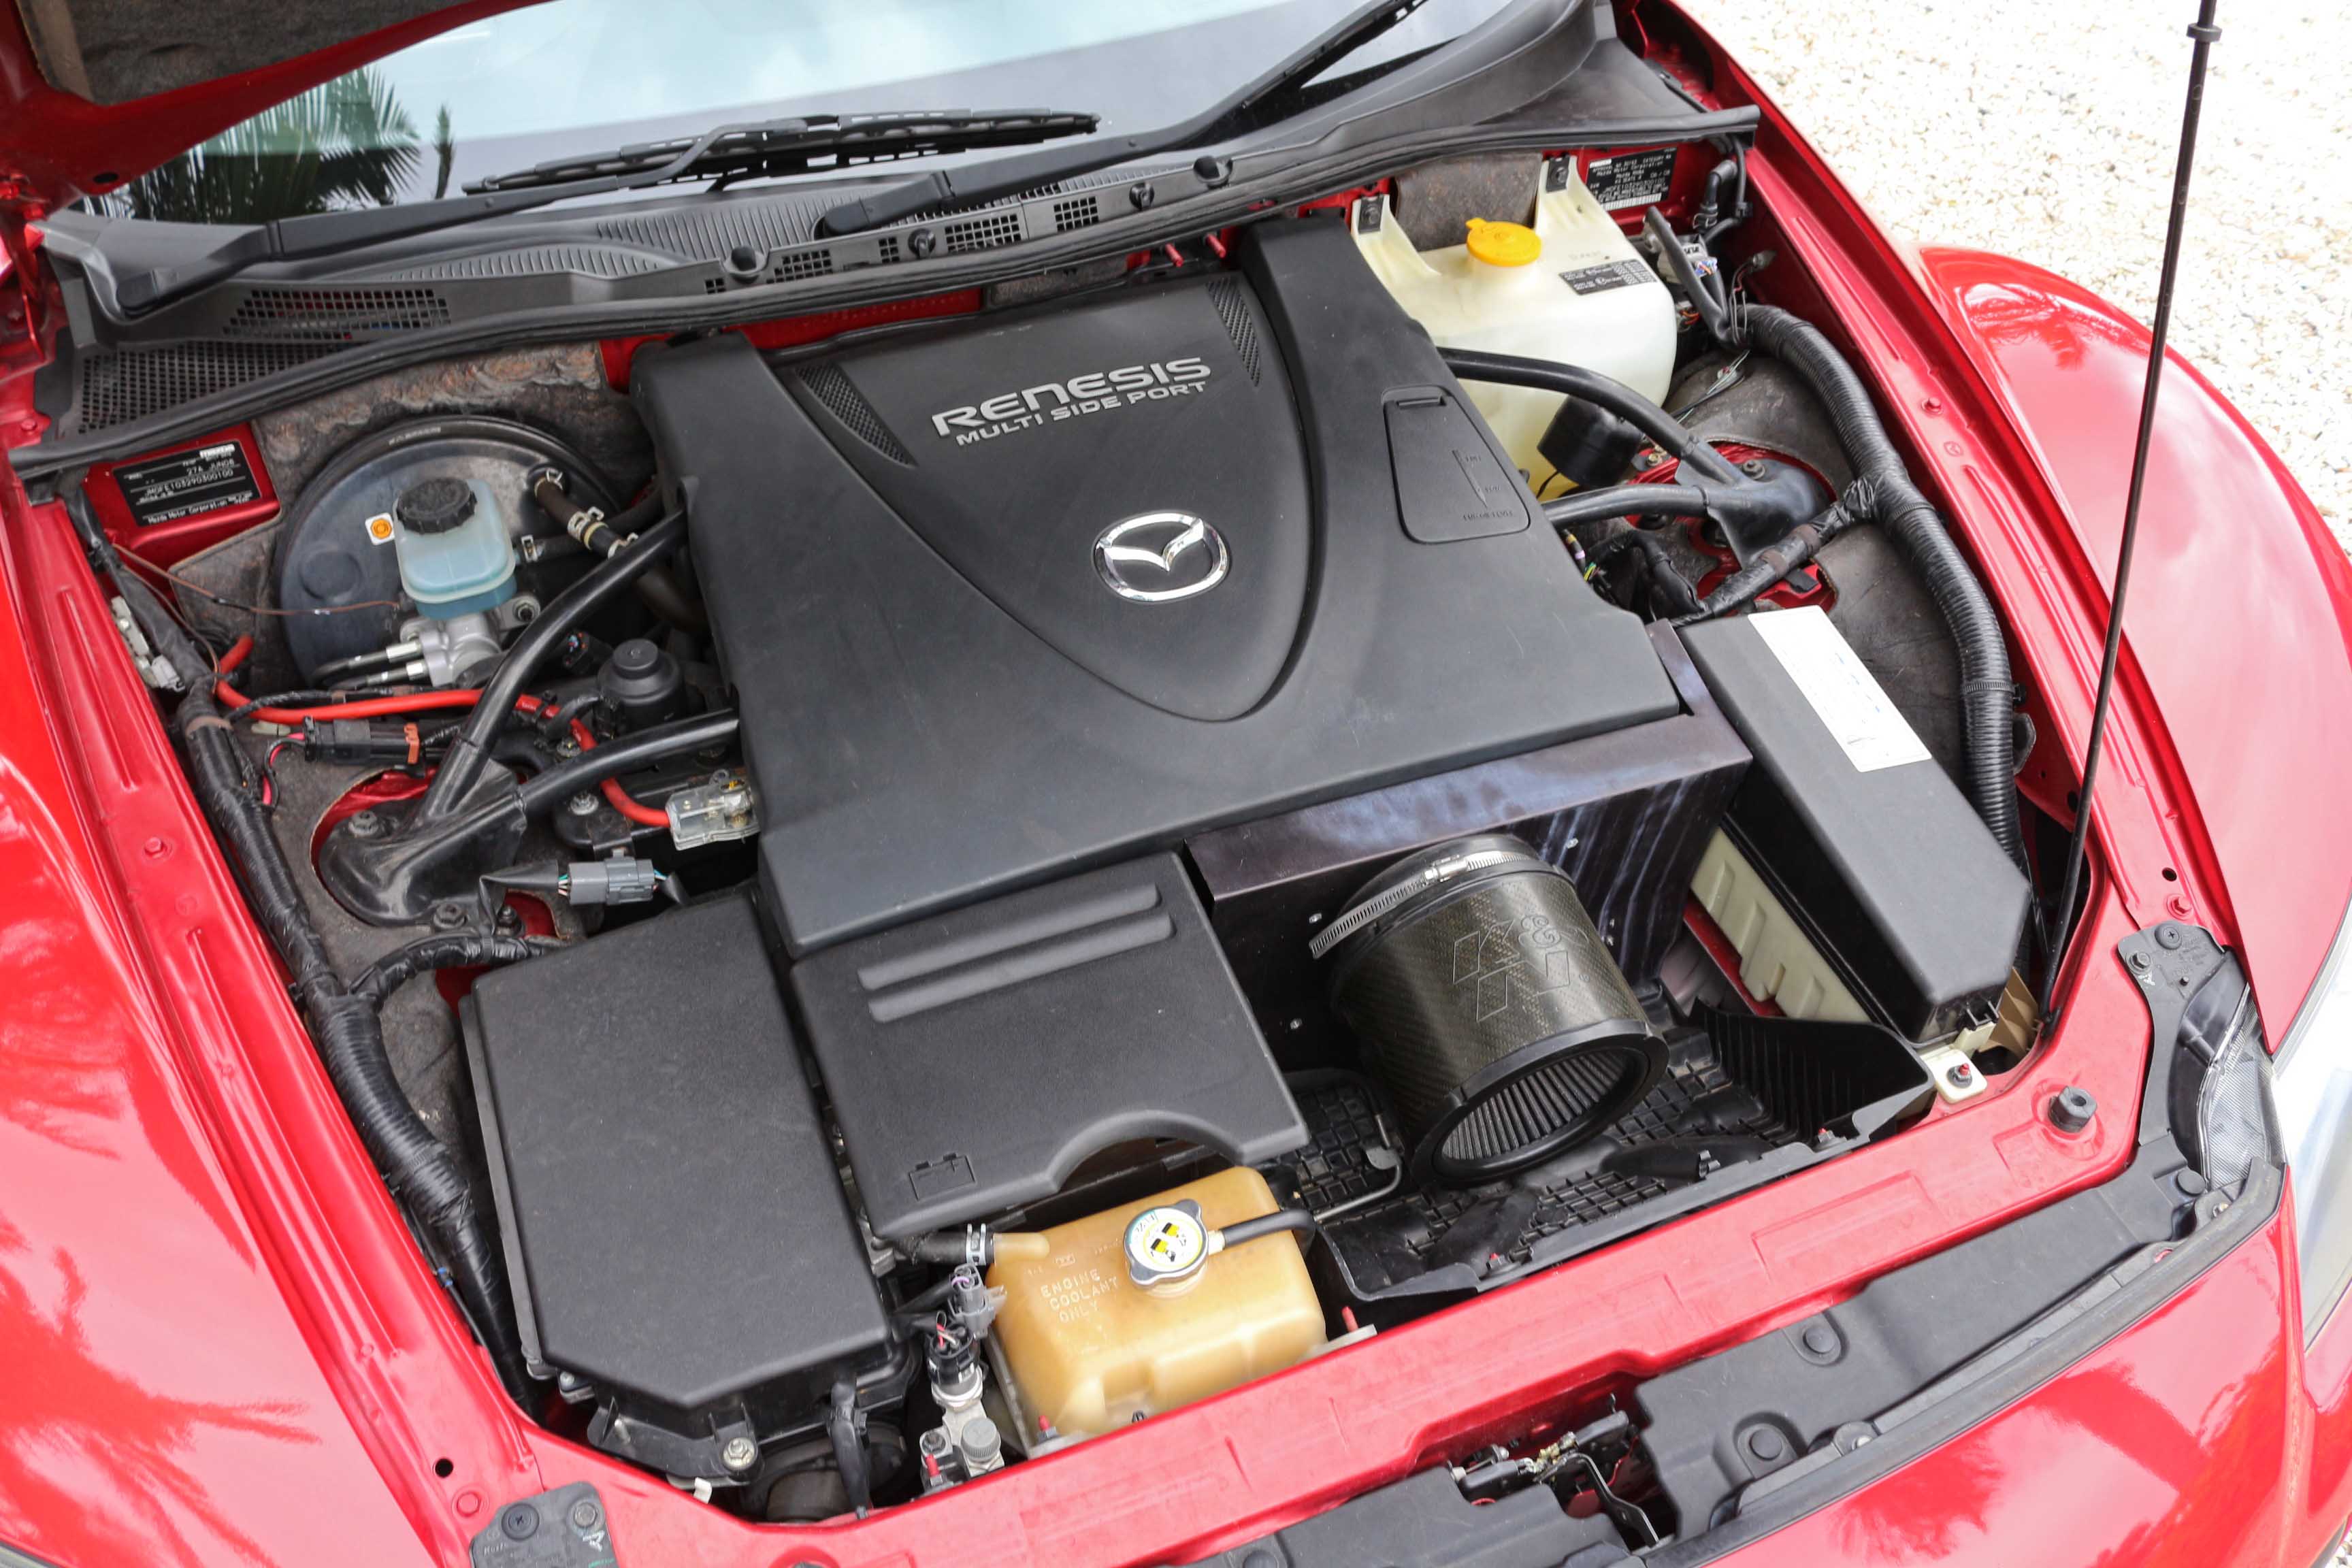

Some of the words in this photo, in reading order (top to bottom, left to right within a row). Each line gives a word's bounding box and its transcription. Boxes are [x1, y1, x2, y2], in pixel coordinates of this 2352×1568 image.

[931, 357, 1211, 438] RENESIS
[956, 413, 1045, 446] MULTI
[1050, 395, 1122, 422] SIDE
[1127, 380, 1207, 405] PORT
[1040, 1268, 1101, 1298] ENGINE
[1049, 1276, 1120, 1311] COOLANT
[1058, 1300, 1100, 1324] ONLY
